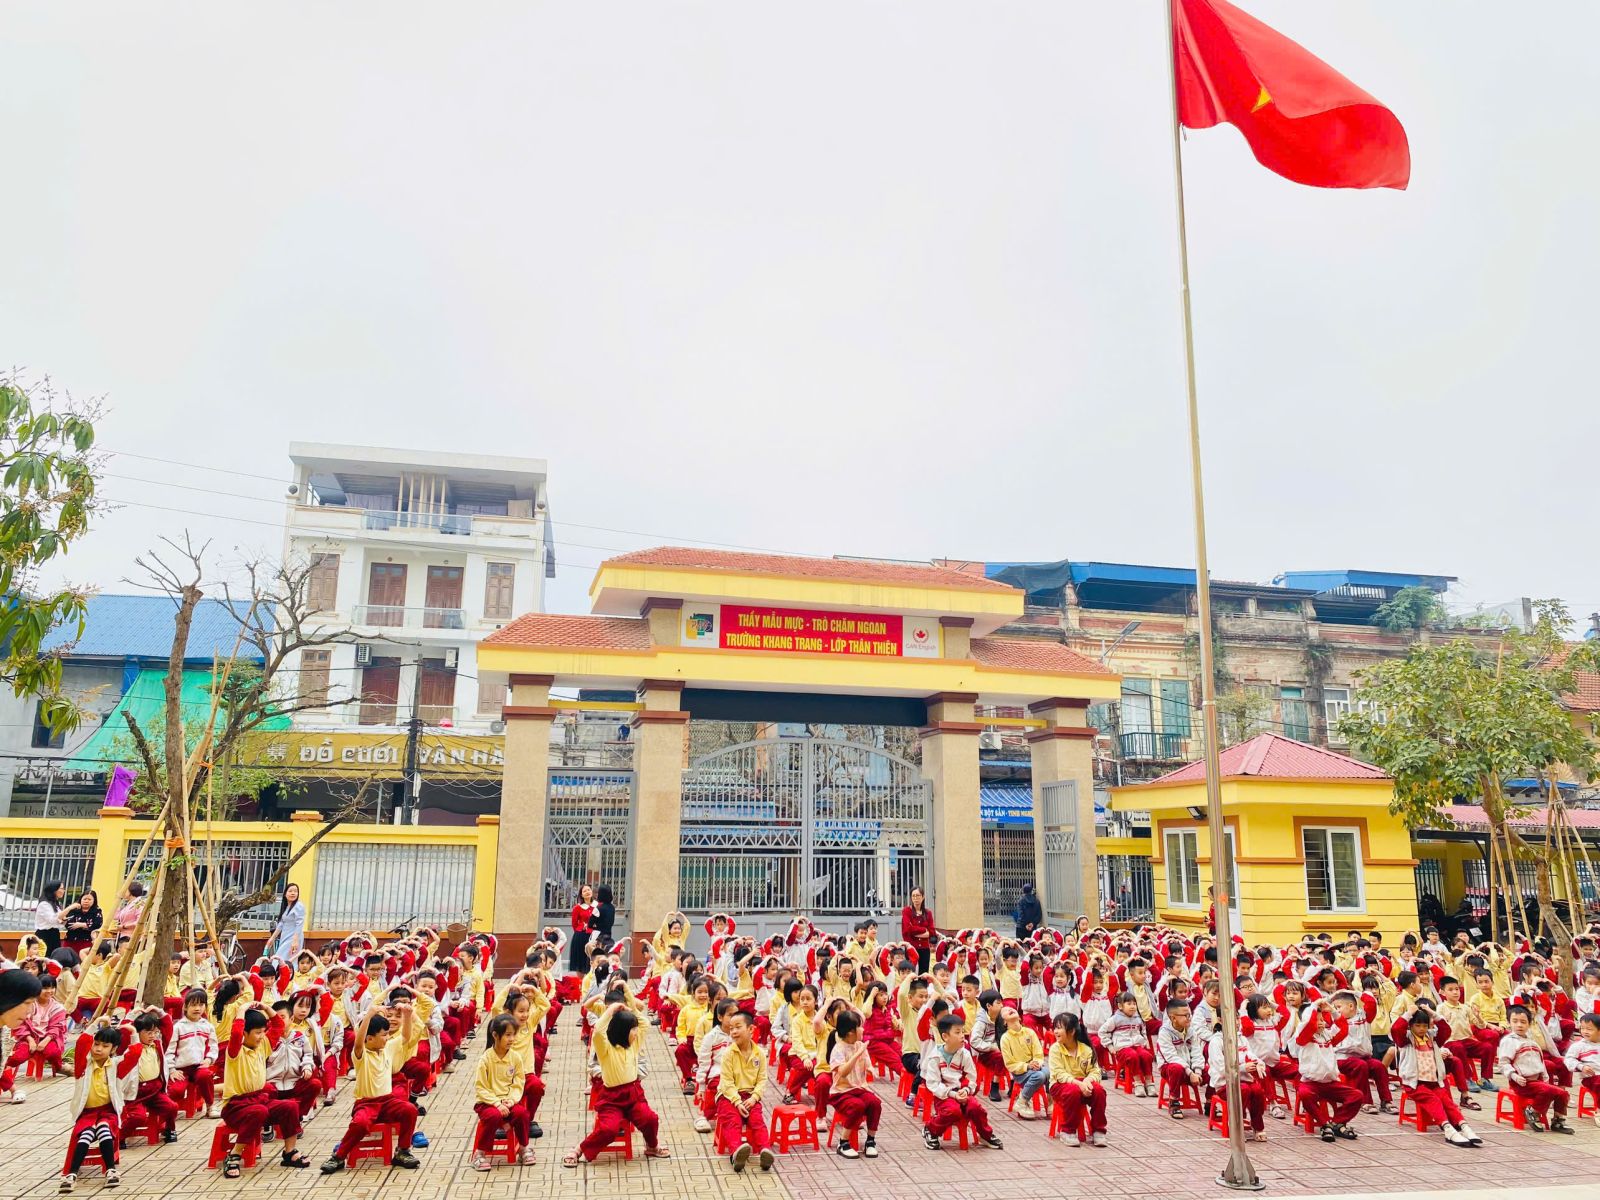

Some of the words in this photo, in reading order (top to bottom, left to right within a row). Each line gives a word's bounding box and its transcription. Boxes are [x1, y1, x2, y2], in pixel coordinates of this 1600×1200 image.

[762, 611, 782, 629] MẪU
[784, 616, 804, 632] MỰC
[812, 616, 828, 632] TRÒ
[830, 617, 855, 633] CHĂM
[857, 621, 887, 635] NGOAN
[726, 631, 760, 648] TRƯỜNG
[763, 635, 793, 649] KHANG
[795, 637, 822, 651] TRANG
[830, 637, 847, 652] LỚP
[849, 638, 871, 654] THÂN
[873, 640, 897, 656] THIỆN
[299, 737, 334, 762] ĐỒ
[48, 806, 57, 816] &
